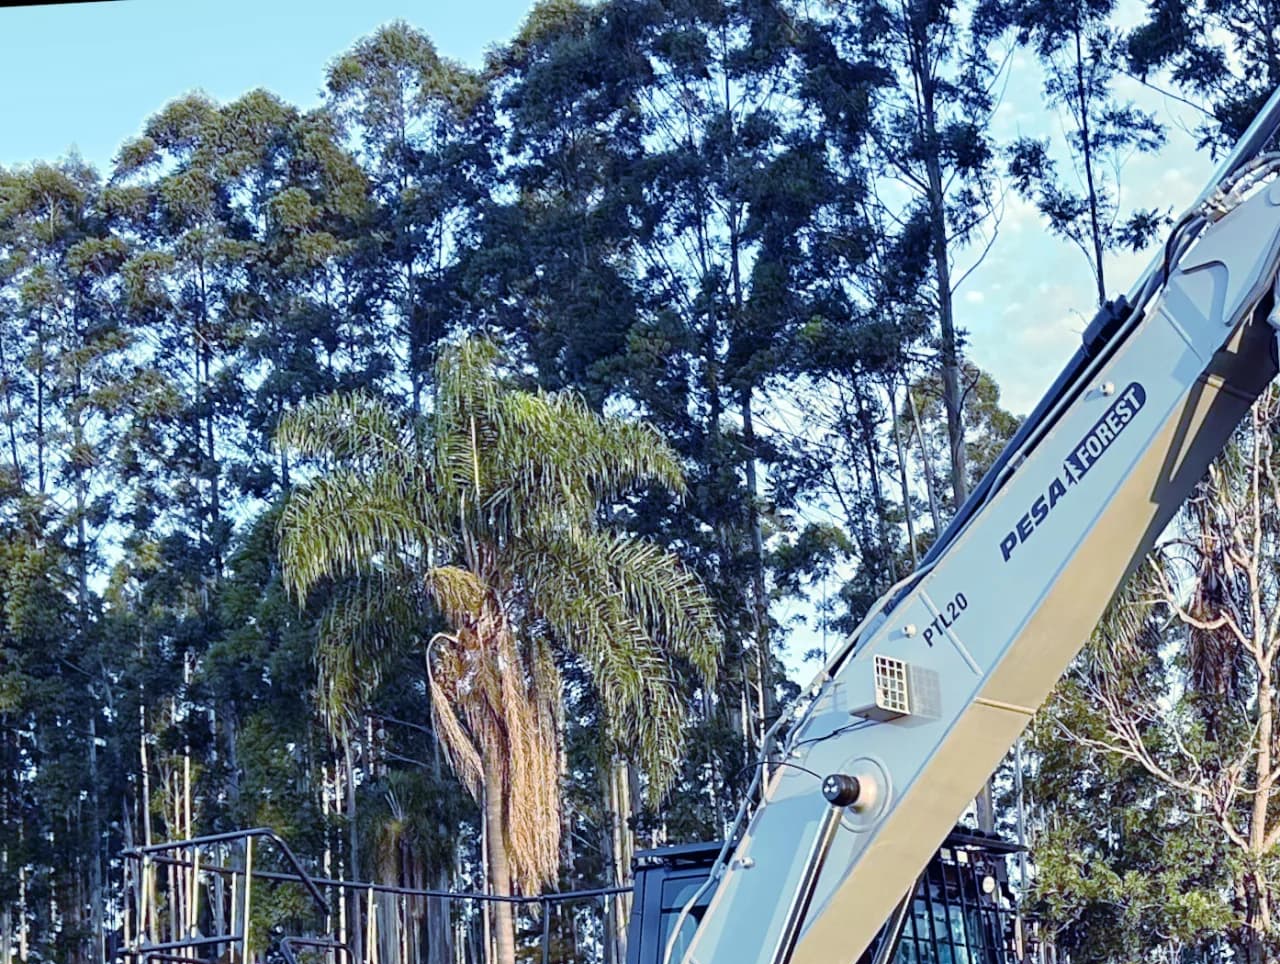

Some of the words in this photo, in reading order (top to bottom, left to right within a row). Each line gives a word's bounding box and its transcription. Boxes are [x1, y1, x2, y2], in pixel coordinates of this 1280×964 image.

[999, 476, 1068, 563] PESA
[1075, 386, 1142, 470] FOREST
[921, 591, 969, 648] PTL20
